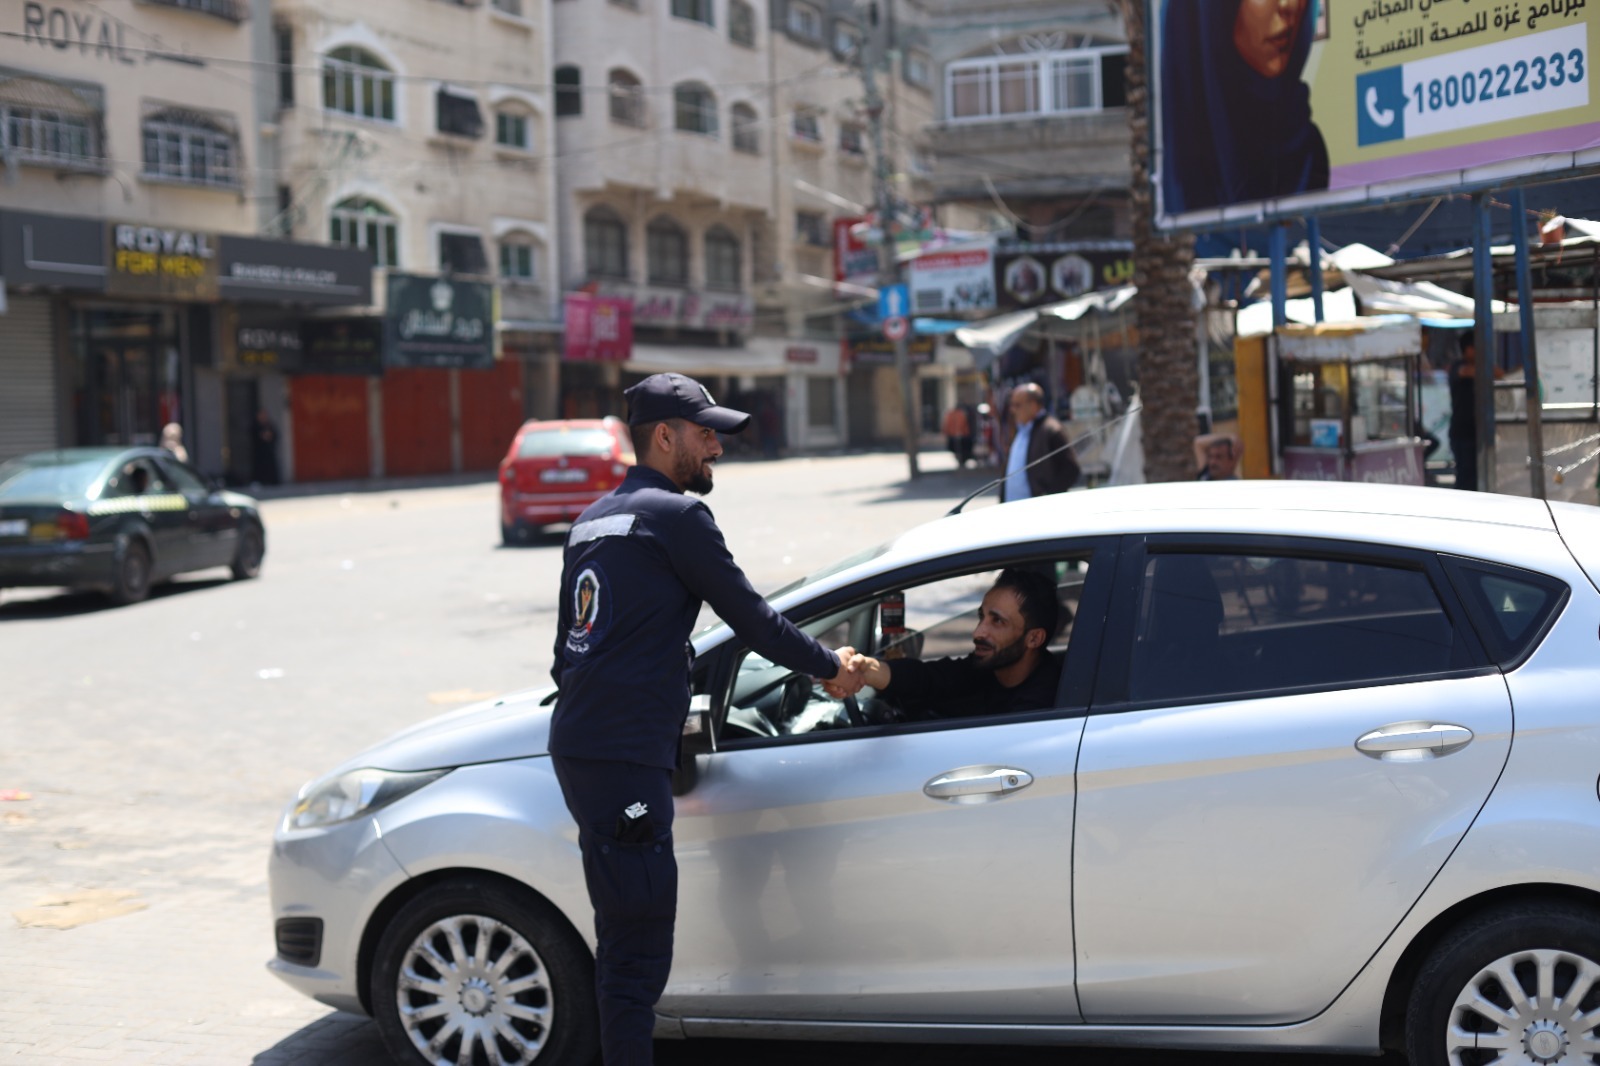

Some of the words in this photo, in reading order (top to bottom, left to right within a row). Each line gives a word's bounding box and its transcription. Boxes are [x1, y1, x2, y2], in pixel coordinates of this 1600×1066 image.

[23, 2, 136, 66] ROYAL
[1430, 10, 1488, 42] للصحة
[1494, 2, 1521, 32] غزة
[1355, 27, 1424, 66] النفسية
[1413, 47, 1585, 115] 1800222333
[115, 224, 215, 259] ROYAL
[115, 252, 157, 276] FOR
[161, 255, 206, 279] MEN
